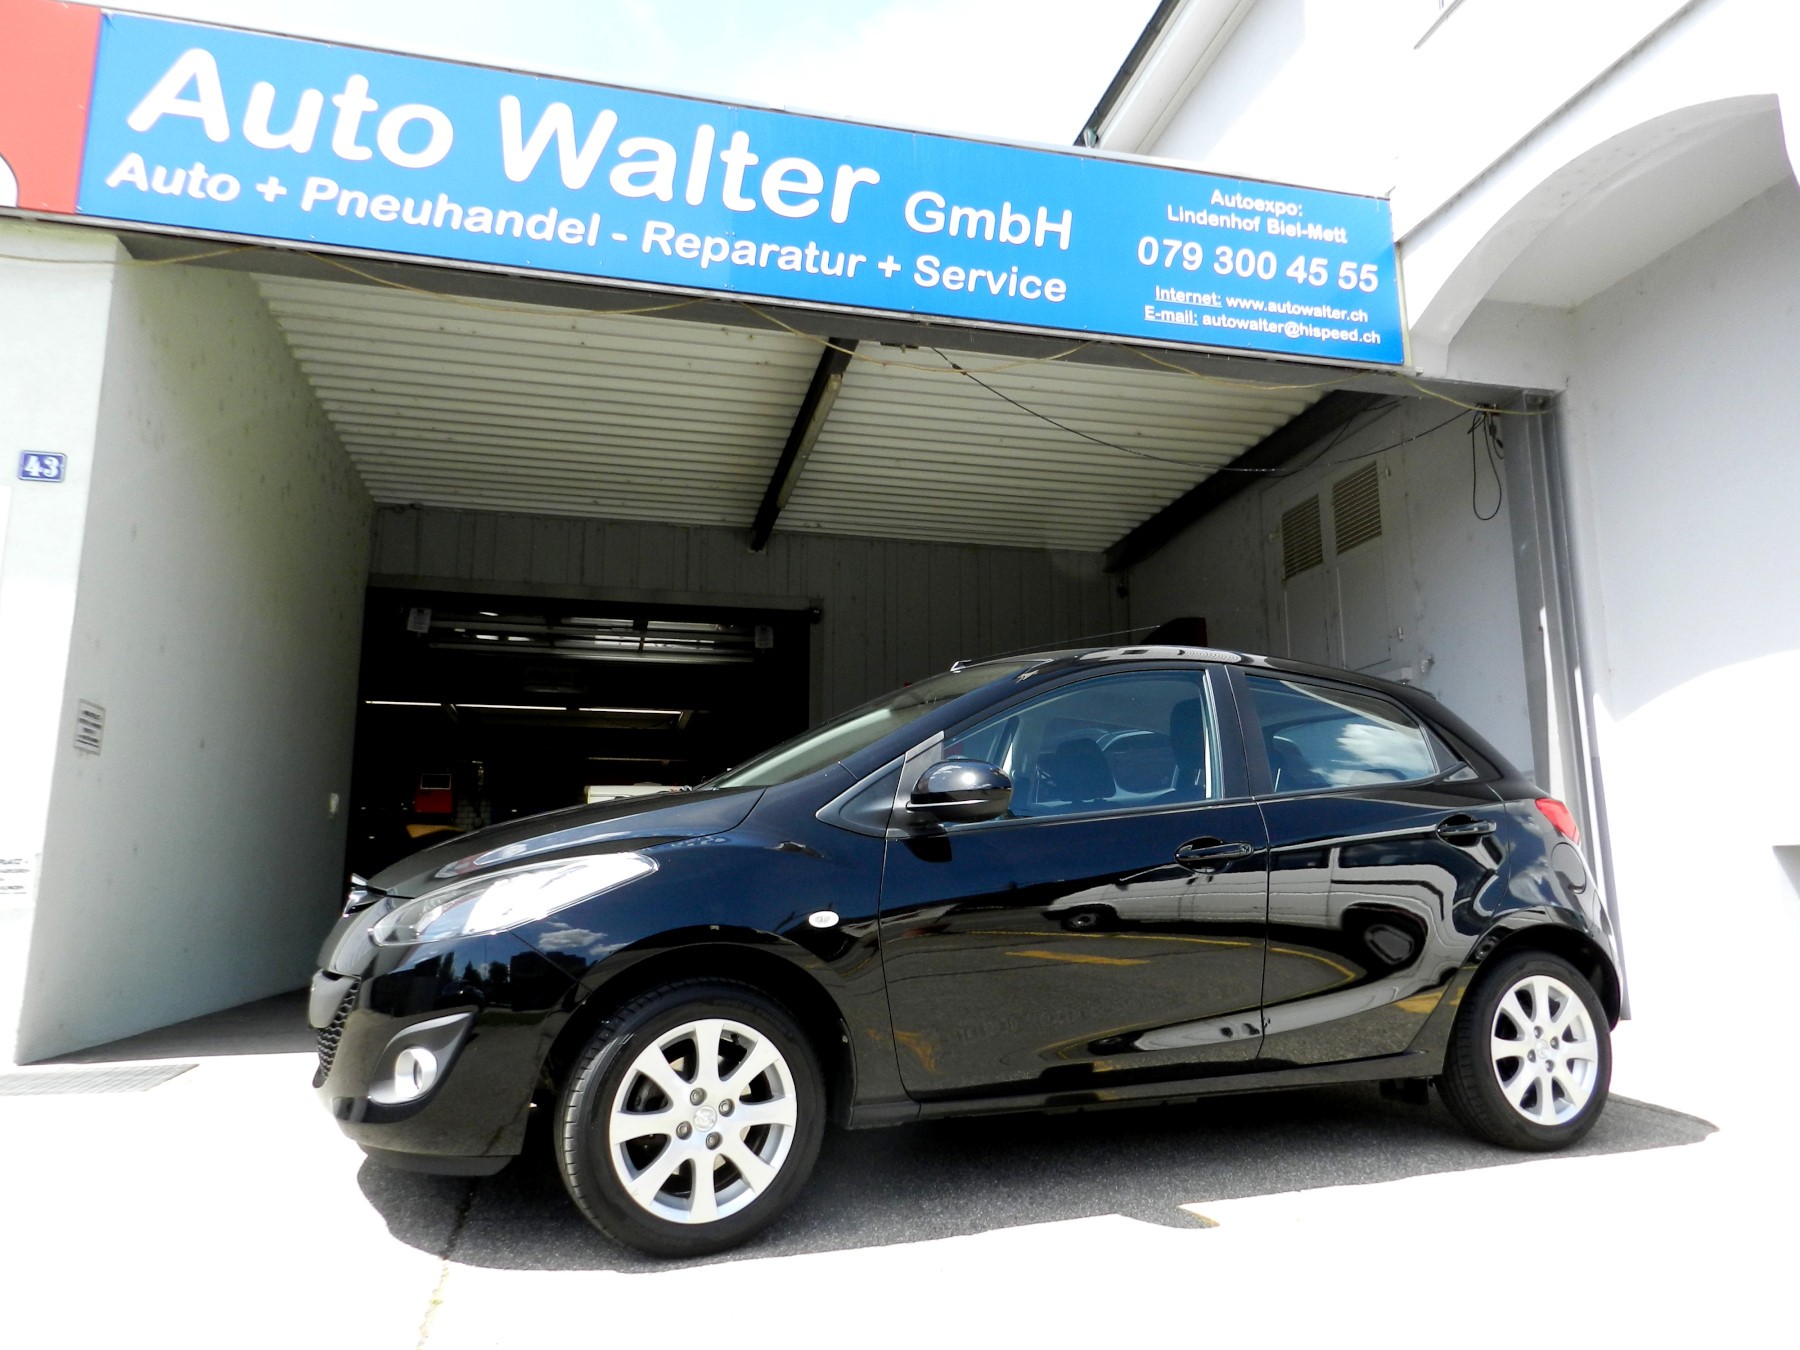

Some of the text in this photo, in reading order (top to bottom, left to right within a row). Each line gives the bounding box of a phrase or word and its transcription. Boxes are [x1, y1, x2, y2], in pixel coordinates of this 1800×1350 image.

[124, 46, 1073, 250] Auto Walter GmbH
[1210, 189, 1303, 217] Autoexpo:
[104, 151, 1067, 302] Auto + Pneuhandel - Reparatur + Service
[1167, 204, 1348, 245] Lindenhof Biel-Mett
[1137, 236, 1379, 293] 079 300 45 55
[1155, 285, 1368, 323] Internet: www.autowalter.ch
[1143, 305, 1381, 345] E-mail: autowalter@hispeed.ch
[24, 455, 60, 478] 43
